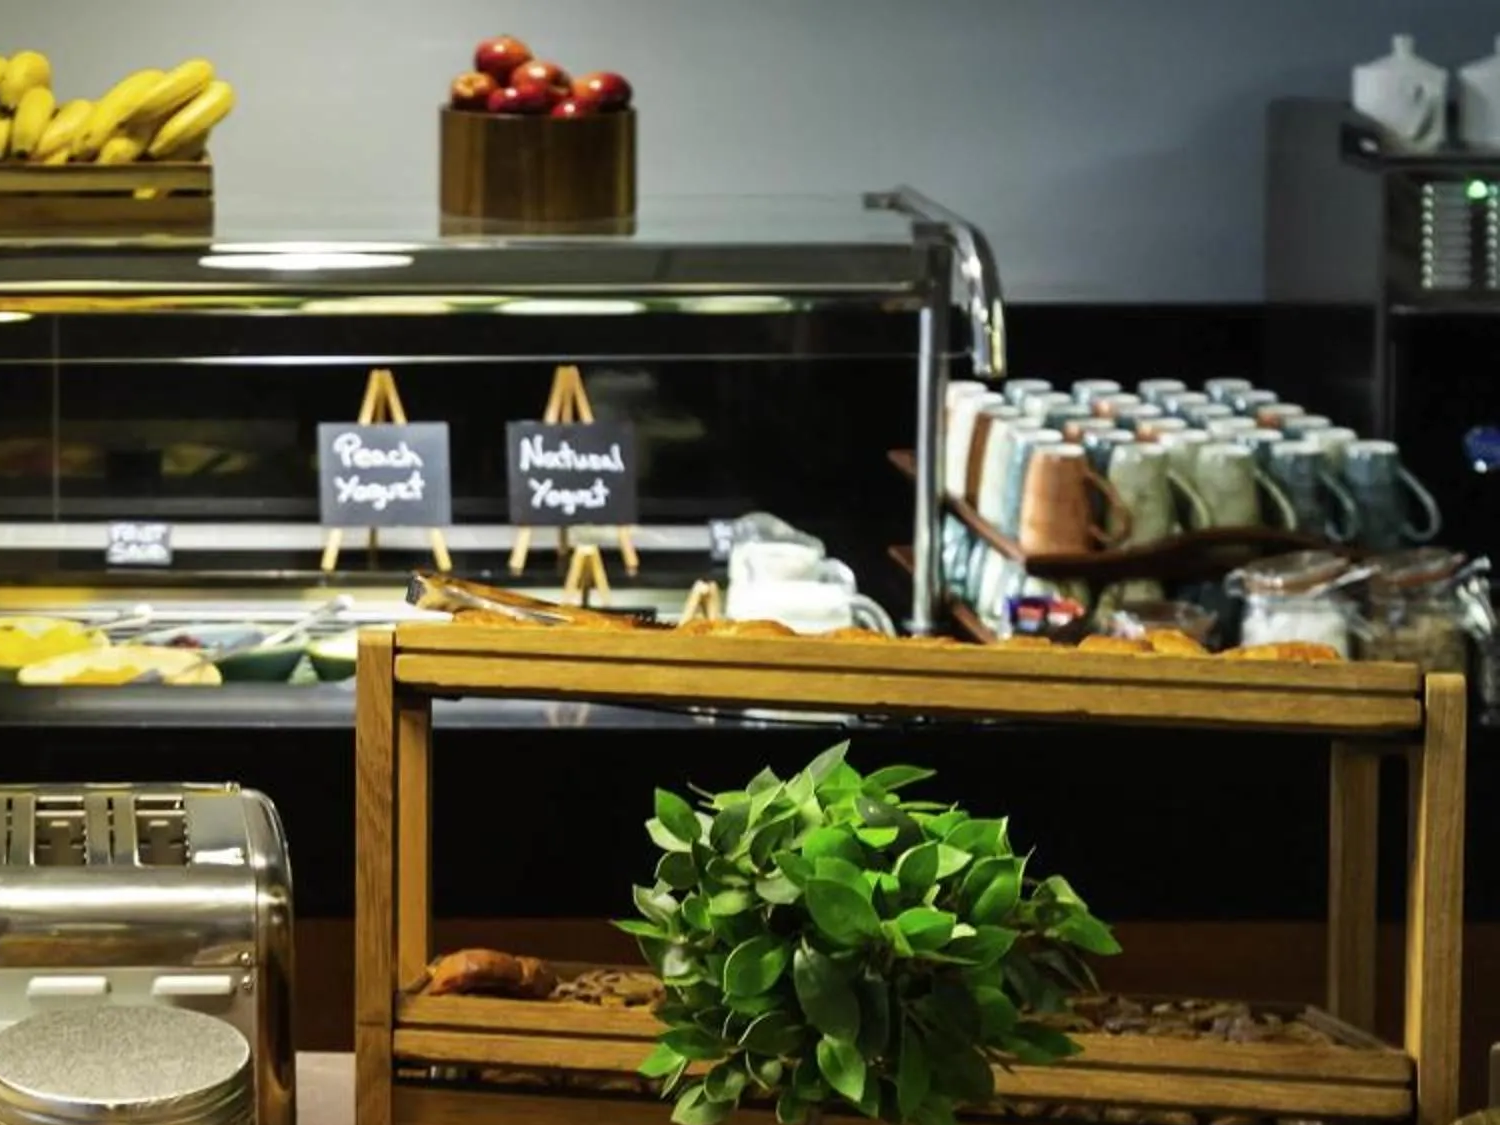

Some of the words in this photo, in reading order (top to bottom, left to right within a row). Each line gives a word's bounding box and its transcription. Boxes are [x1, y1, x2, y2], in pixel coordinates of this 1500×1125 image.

[333, 432, 424, 469] Peach
[519, 435, 626, 473] Natural
[333, 470, 426, 511] Yogurt
